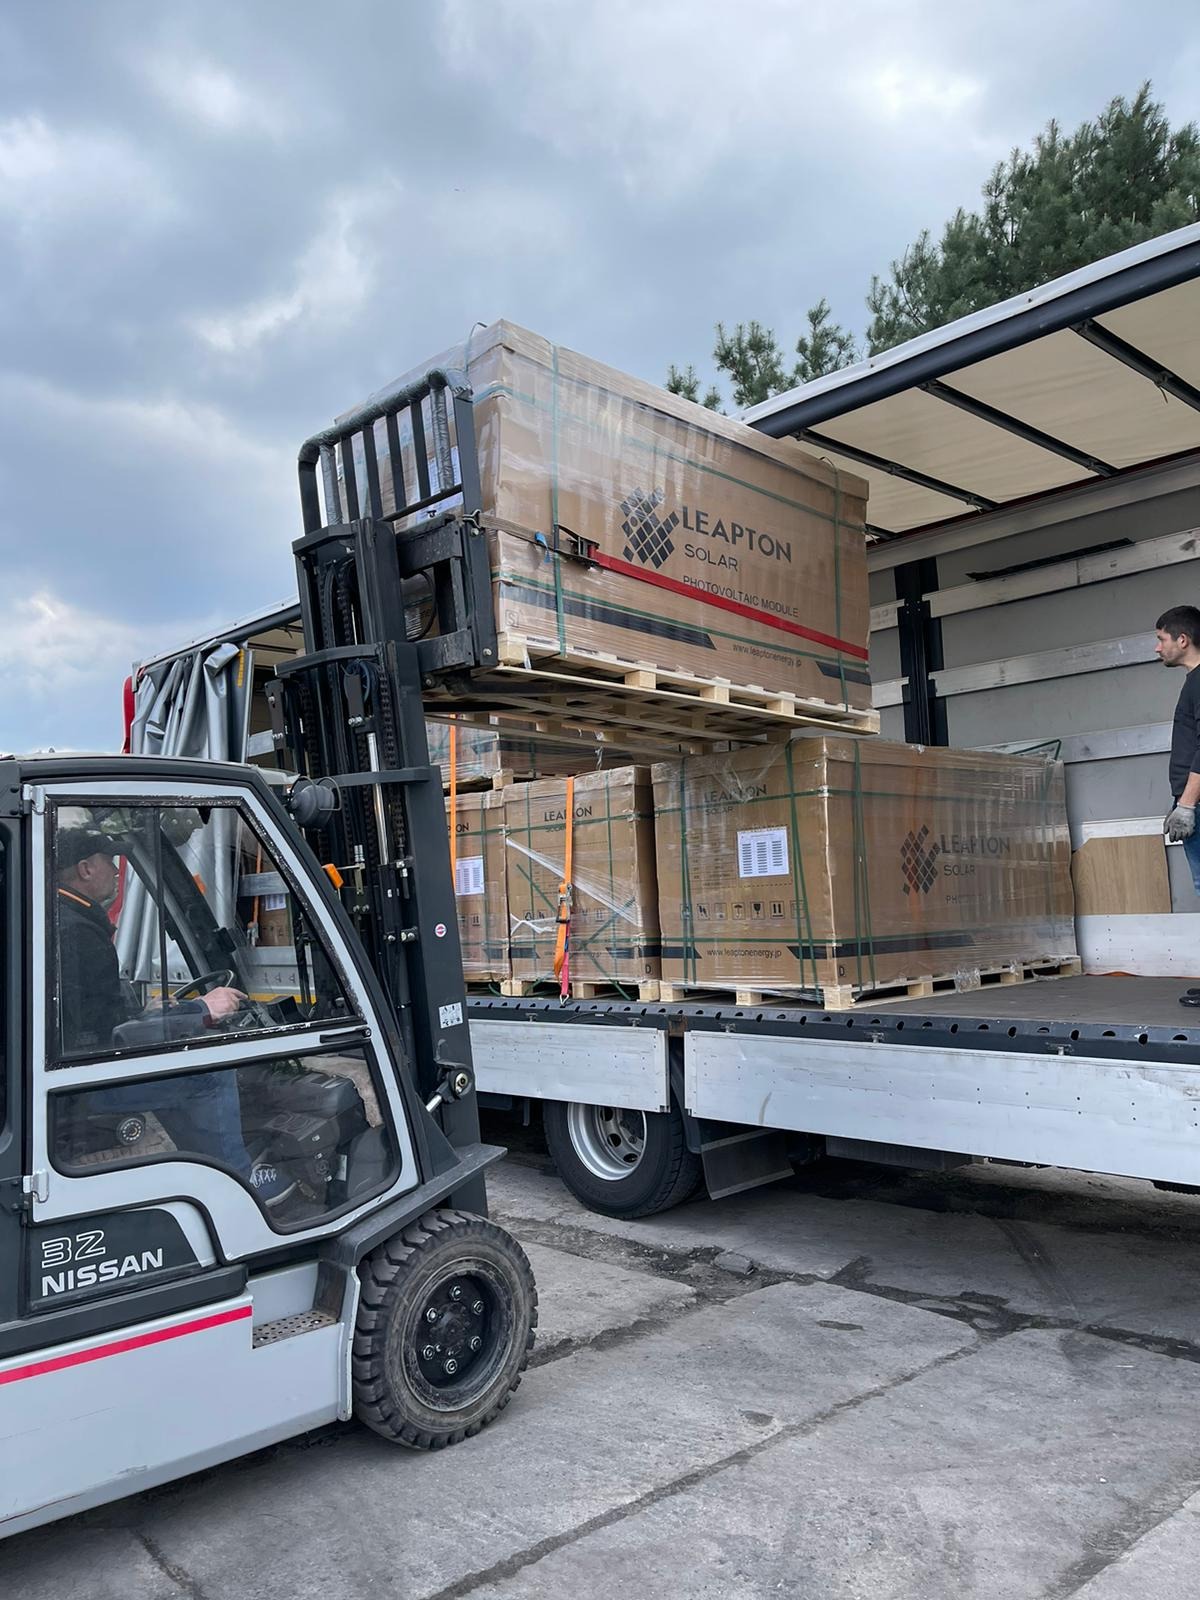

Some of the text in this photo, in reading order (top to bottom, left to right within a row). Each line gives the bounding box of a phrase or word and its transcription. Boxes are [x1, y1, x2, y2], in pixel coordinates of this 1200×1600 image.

[682, 505, 792, 564] LEAPTON
[684, 543, 739, 572] SOLAR
[683, 575, 799, 618] PHOTOVOLTAIC MODULE
[544, 805, 593, 822] LEAON
[41, 1230, 106, 1269] 32
[41, 1248, 163, 1297] NISSAN
